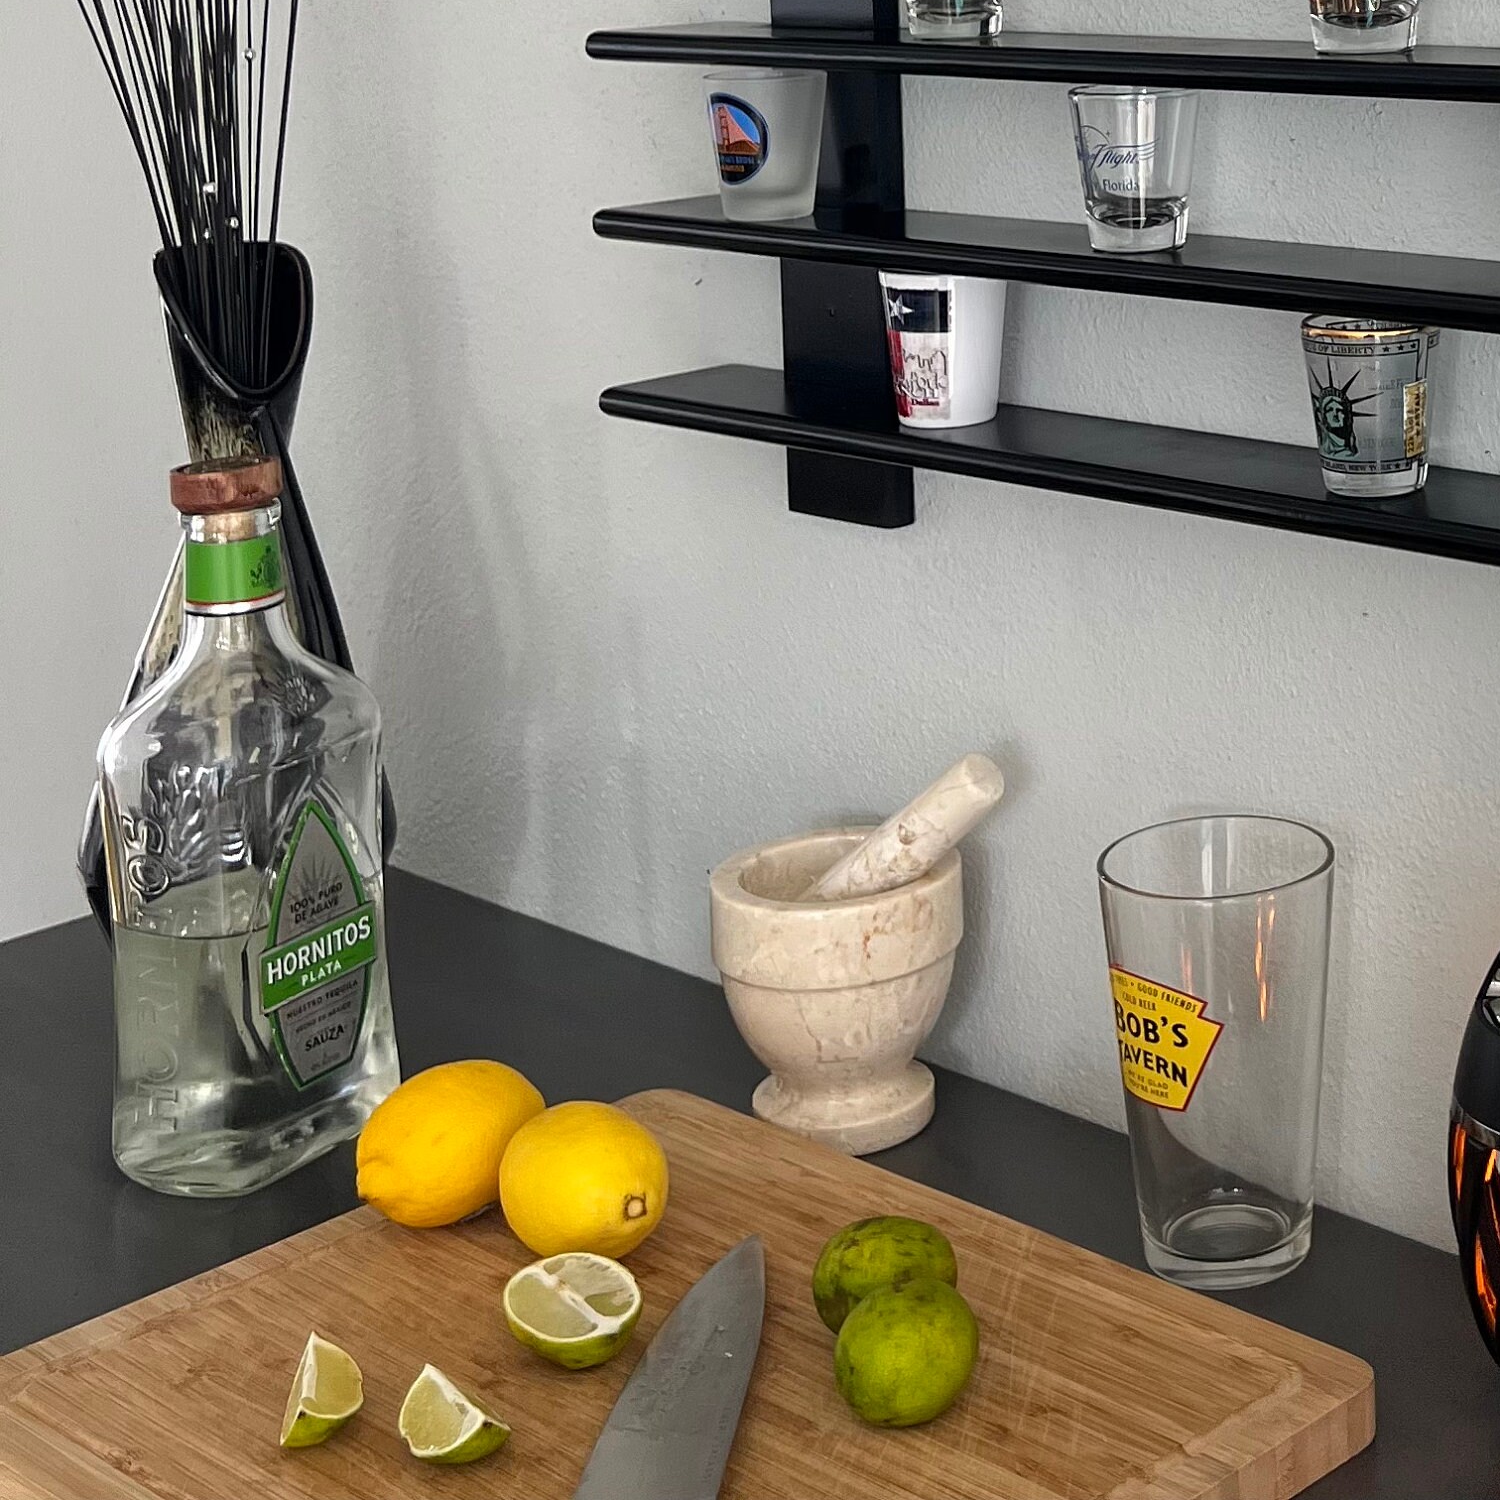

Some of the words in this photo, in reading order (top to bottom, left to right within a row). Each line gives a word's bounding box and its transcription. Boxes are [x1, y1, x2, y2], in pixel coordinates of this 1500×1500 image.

[1103, 178, 1140, 192] Florida
[1331, 342, 1376, 354] LIBERTY
[294, 910, 307, 924] DE
[267, 915, 371, 985] HORNITOS
[301, 961, 342, 987] PLATA
[1136, 981, 1159, 999] GOOD
[1161, 991, 1198, 1014] FRIENDS
[1114, 998, 1189, 1048] BOB'S
[304, 1024, 345, 1052] SAUZA
[1117, 1039, 1188, 1088] TAVERN
